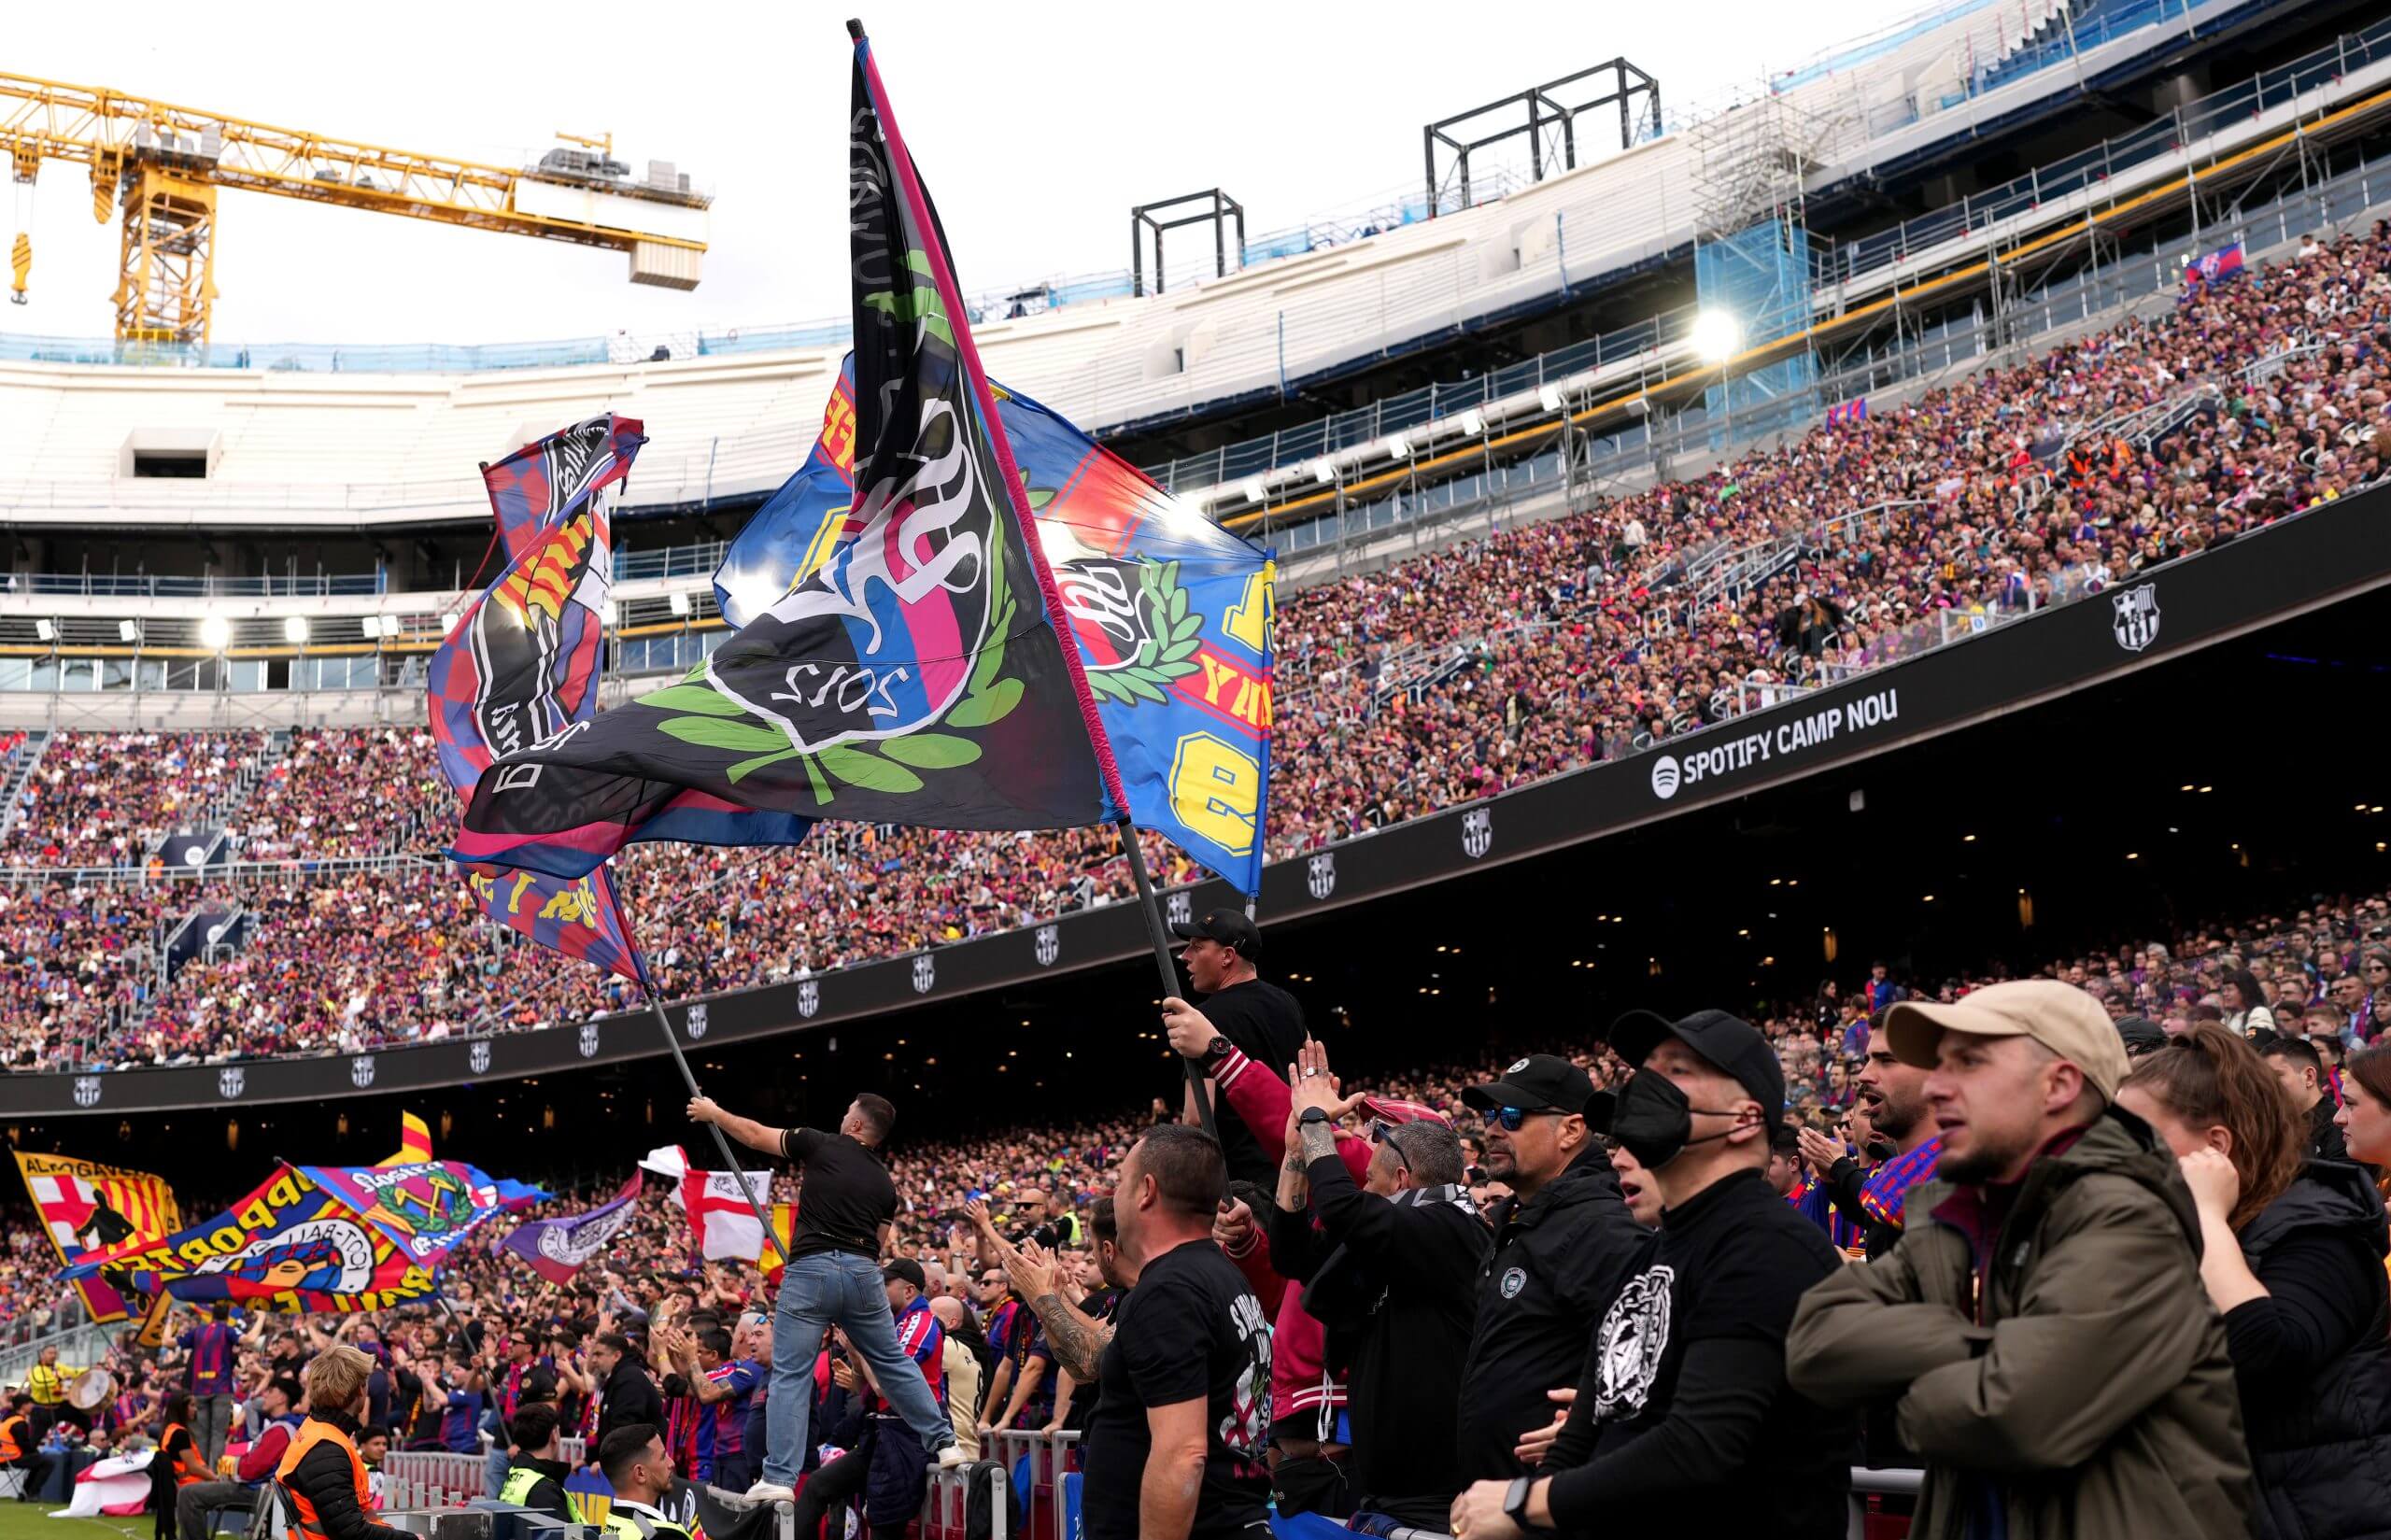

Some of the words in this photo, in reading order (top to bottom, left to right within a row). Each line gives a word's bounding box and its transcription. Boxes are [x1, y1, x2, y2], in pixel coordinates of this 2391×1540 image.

[1683, 730, 1772, 784] SPOTIFY
[1776, 707, 1843, 755] CAMP
[1846, 688, 1899, 733] NOU
